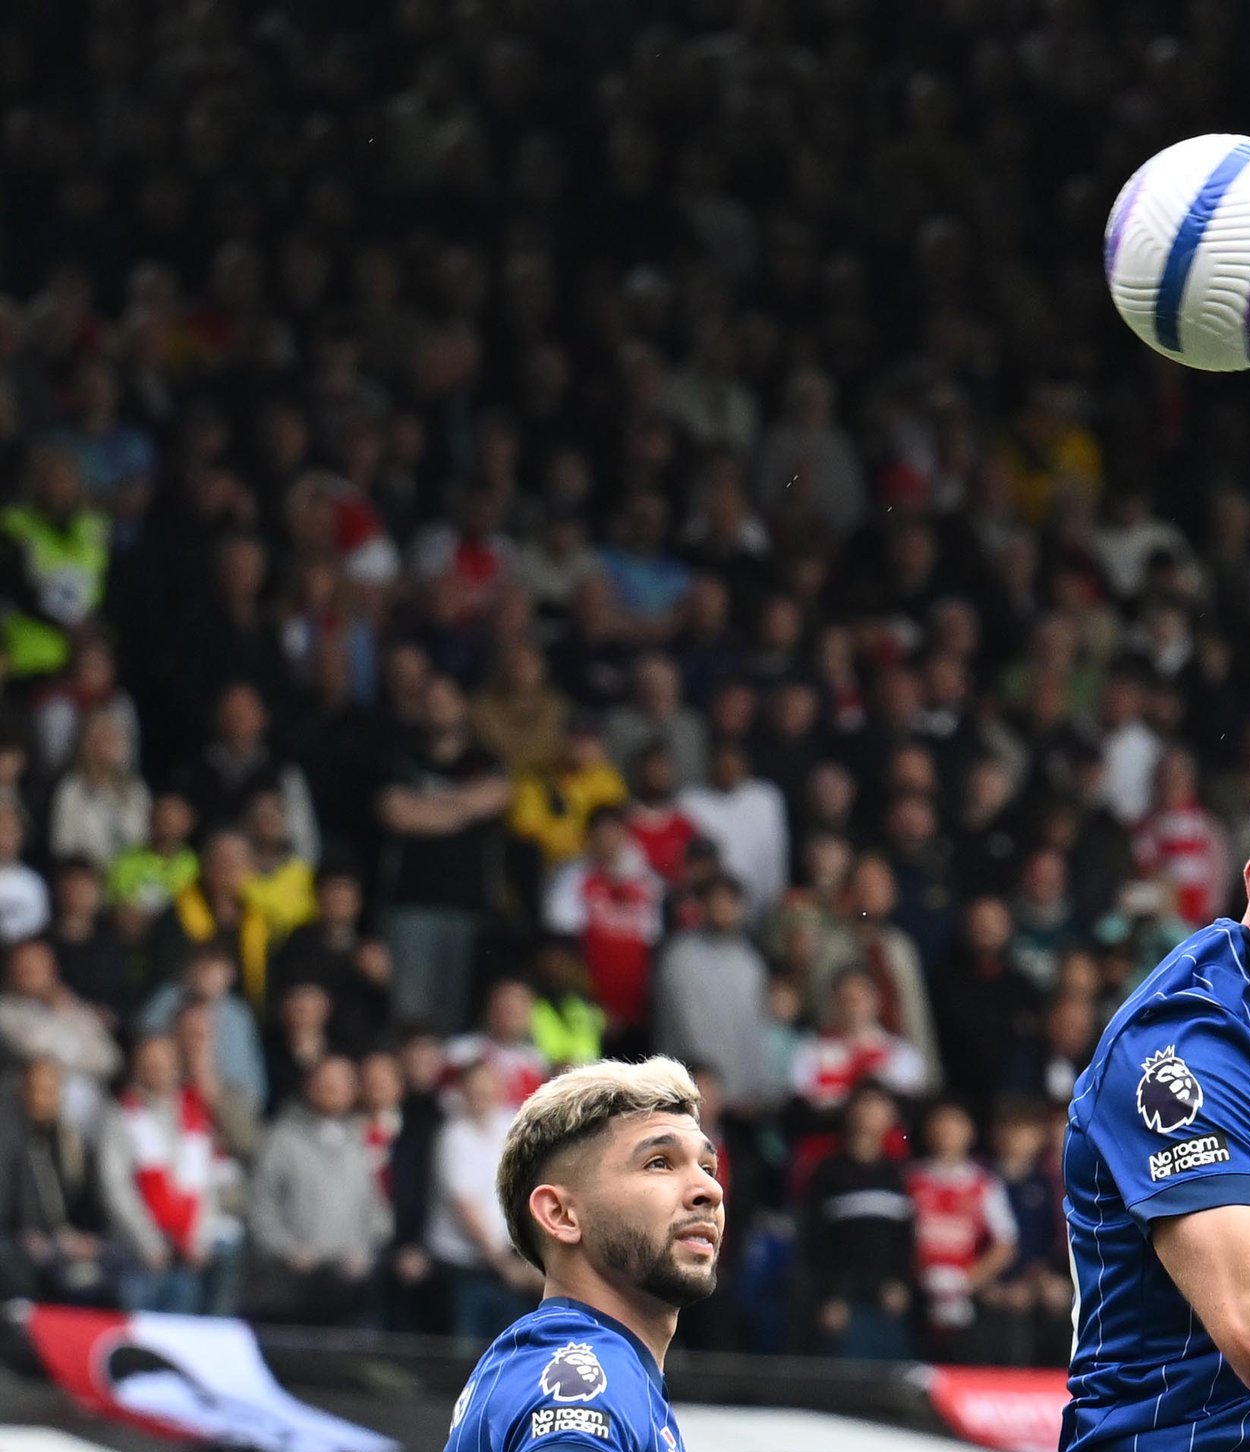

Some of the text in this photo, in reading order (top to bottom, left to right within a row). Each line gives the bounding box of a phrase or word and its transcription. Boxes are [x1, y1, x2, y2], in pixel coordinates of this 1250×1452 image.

[1149, 1136, 1219, 1167] No room
[1150, 1148, 1229, 1182] for racism
[532, 1408, 603, 1424] No room
[532, 1420, 609, 1439] for racism
